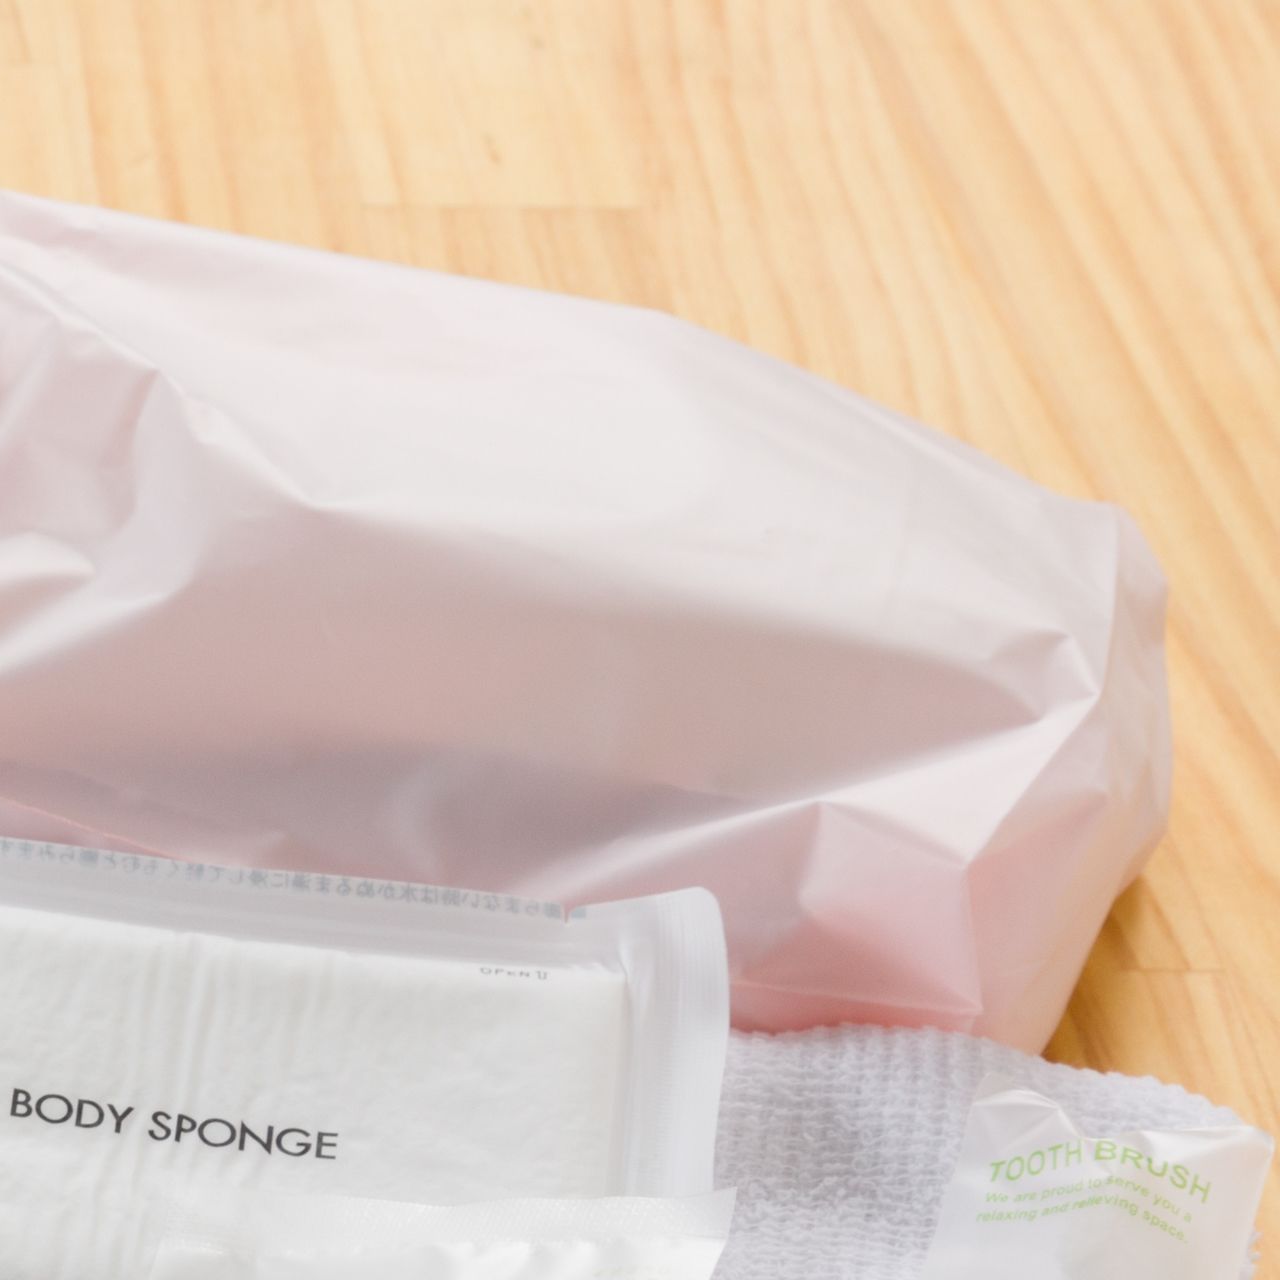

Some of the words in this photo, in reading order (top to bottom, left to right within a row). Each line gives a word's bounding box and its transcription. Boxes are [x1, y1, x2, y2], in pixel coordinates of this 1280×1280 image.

[10, 1088, 134, 1133] BODY
[147, 1111, 339, 1160] SPONGE
[986, 1191, 1009, 1203] We
[1013, 1190, 1037, 1202] are
[1040, 1181, 1084, 1202] proud
[1088, 1177, 1102, 1190] to
[1105, 1174, 1150, 1197] serve
[1153, 1192, 1181, 1215] you
[990, 1141, 1083, 1182] TOOTH
[1094, 1140, 1212, 1203] BRUSH
[976, 1208, 1038, 1224] relaxing
[1041, 1201, 1068, 1217] and
[1071, 1193, 1138, 1217] relieving
